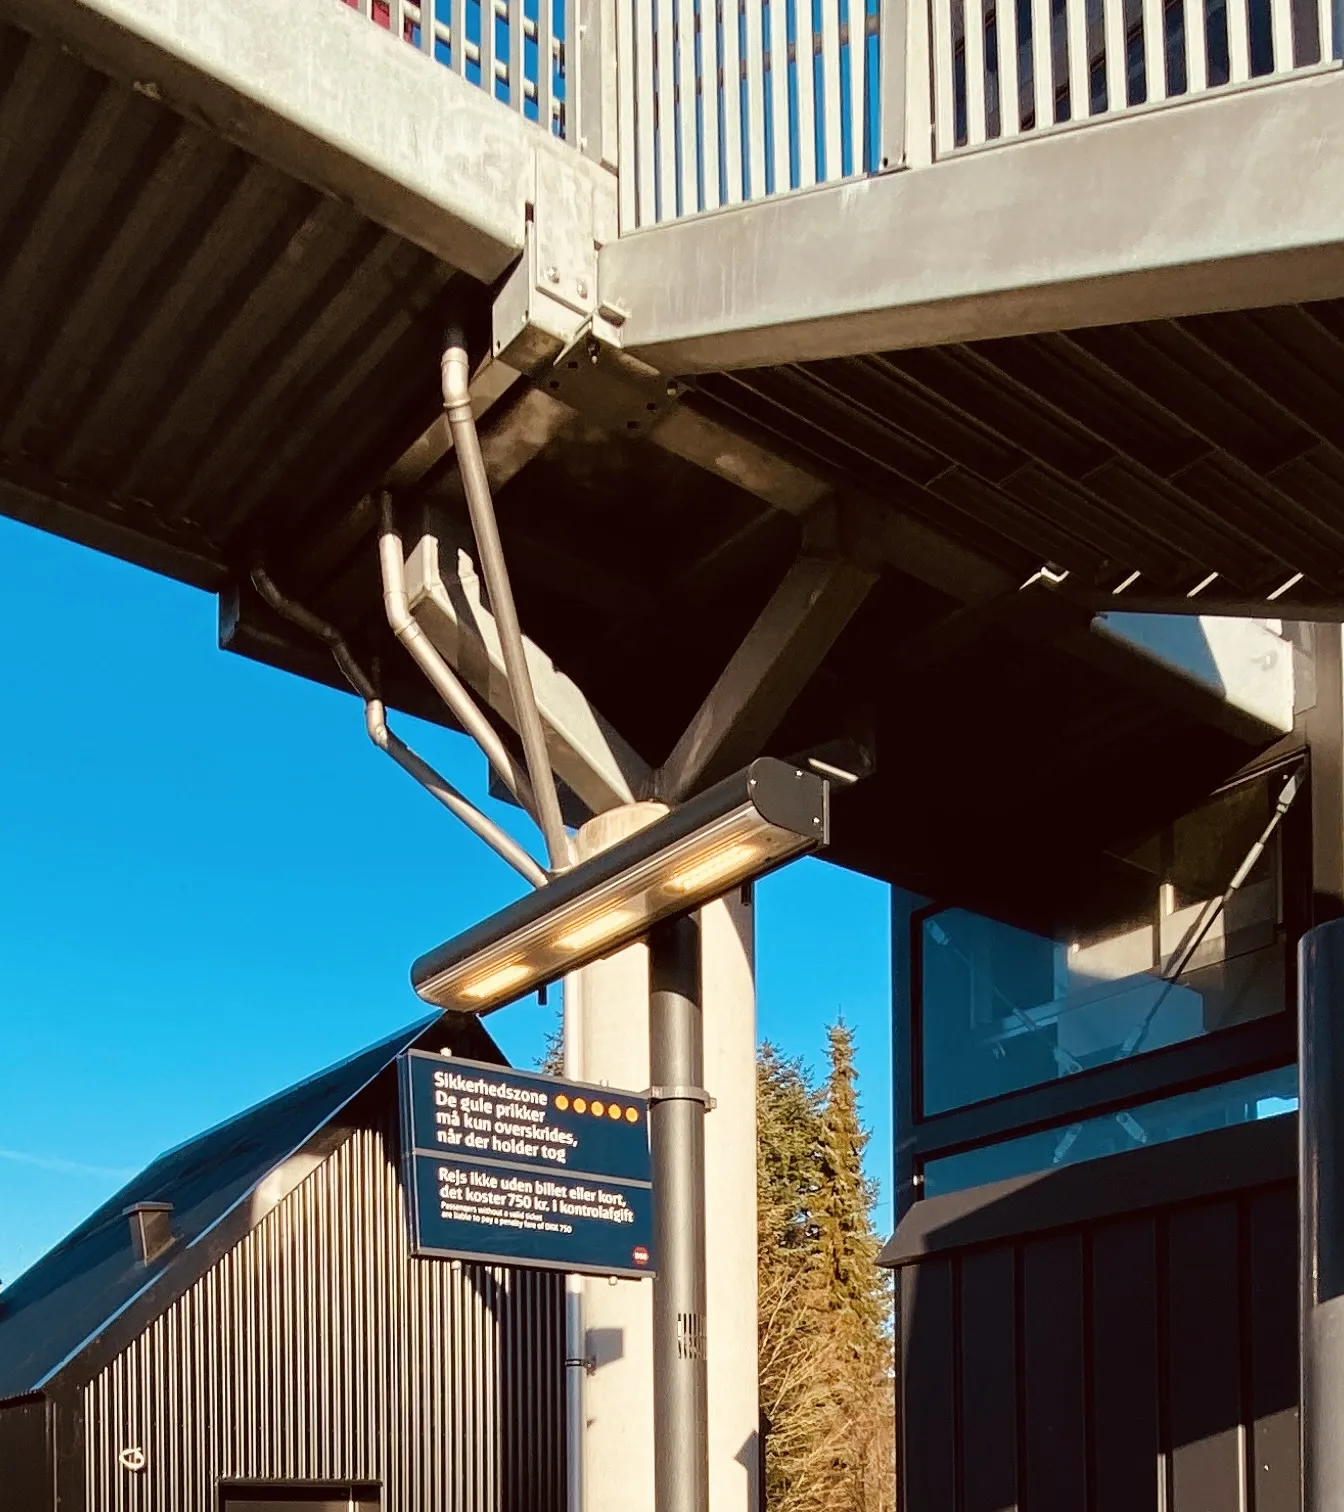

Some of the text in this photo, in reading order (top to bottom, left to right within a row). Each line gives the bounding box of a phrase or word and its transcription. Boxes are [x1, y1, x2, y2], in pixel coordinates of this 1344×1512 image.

[434, 1071, 548, 1105] Sikkerhedszone
[435, 1090, 546, 1123] De gule prikker
[436, 1109, 578, 1147] må kun overskrides,
[437, 1127, 567, 1164] når der holder tog
[438, 1167, 627, 1207] Rejs ikke uden billet eller kort,
[439, 1184, 463, 1201] det
[465, 1187, 507, 1206] koster
[507, 1193, 533, 1209] 750
[534, 1196, 550, 1212] kr.
[559, 1200, 634, 1223] kontrolafgift
